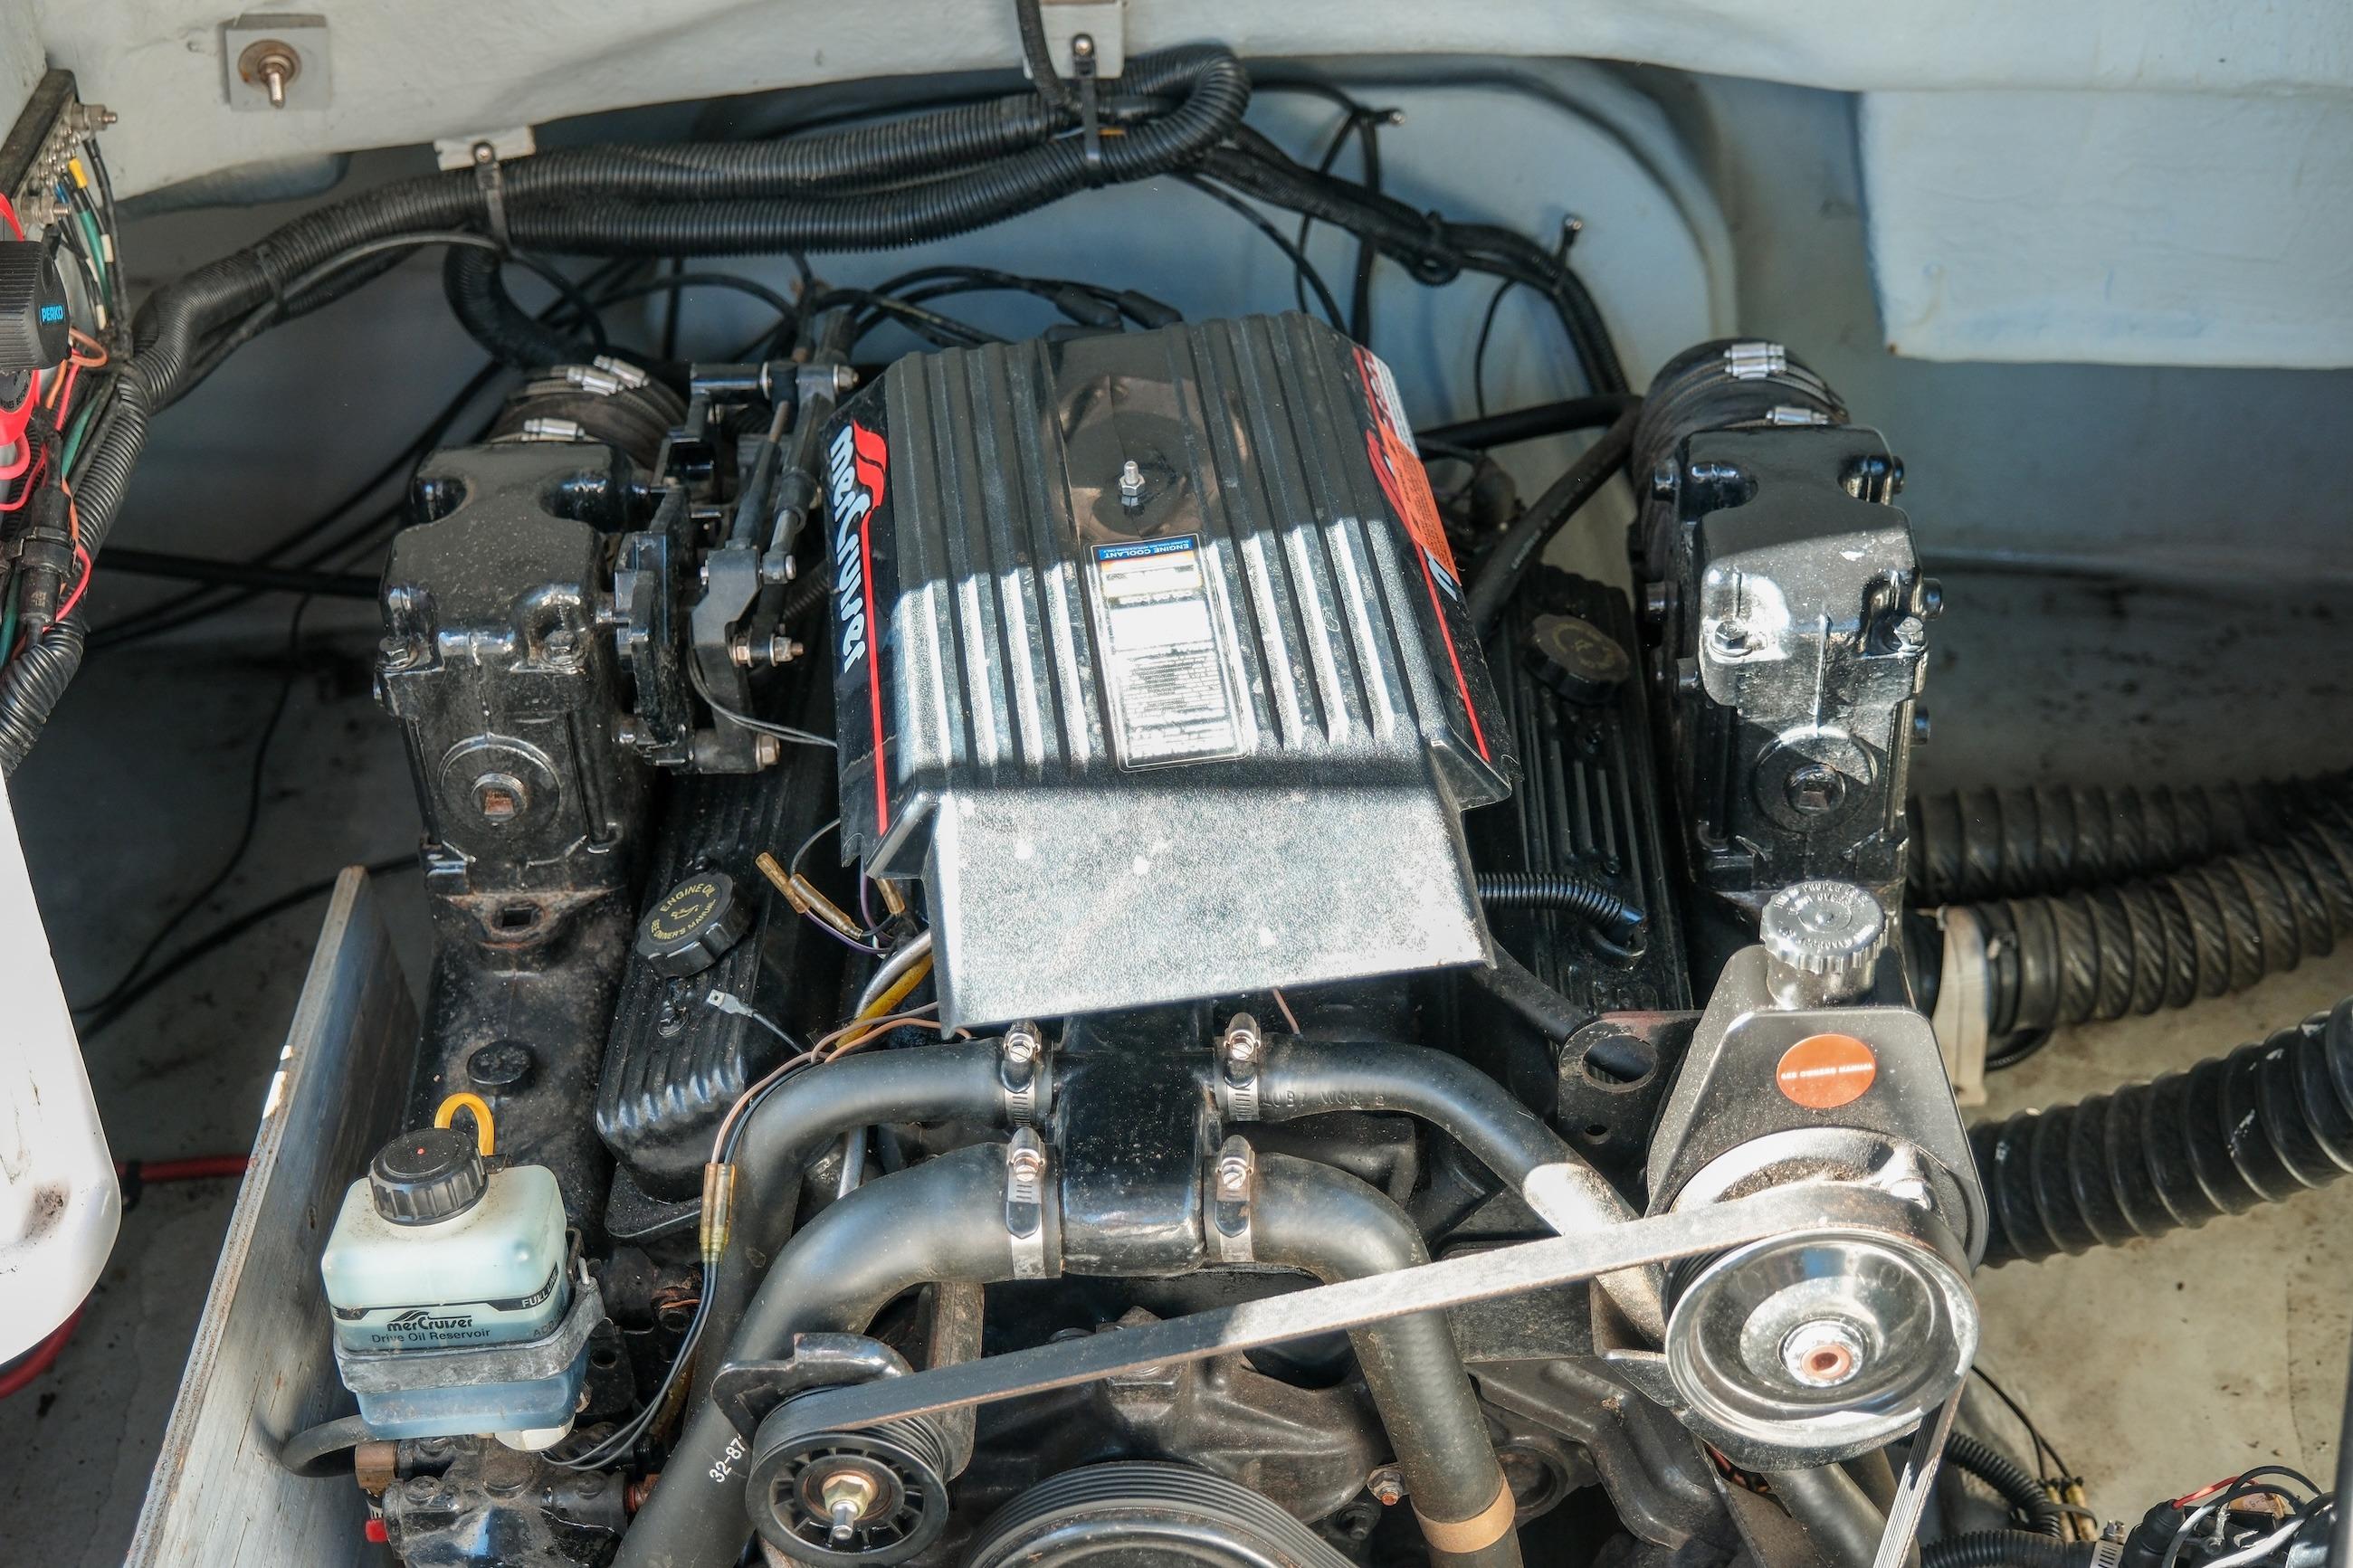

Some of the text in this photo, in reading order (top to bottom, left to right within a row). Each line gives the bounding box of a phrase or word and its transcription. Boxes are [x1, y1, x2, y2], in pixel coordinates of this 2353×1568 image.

[41, 305, 64, 322] PERKO
[830, 425, 871, 673] merCruiser
[1104, 544, 1190, 558] ENGINE COOLANT
[660, 883, 716, 912] ENGINE OIL
[651, 918, 660, 933] SEE
[687, 898, 717, 930] MANUAL
[521, 1290, 548, 1308] FULL
[386, 1315, 472, 1332] merCruiser
[372, 1328, 491, 1345] Drive Oil Reservoir
[710, 1433, 746, 1483] 32-87
